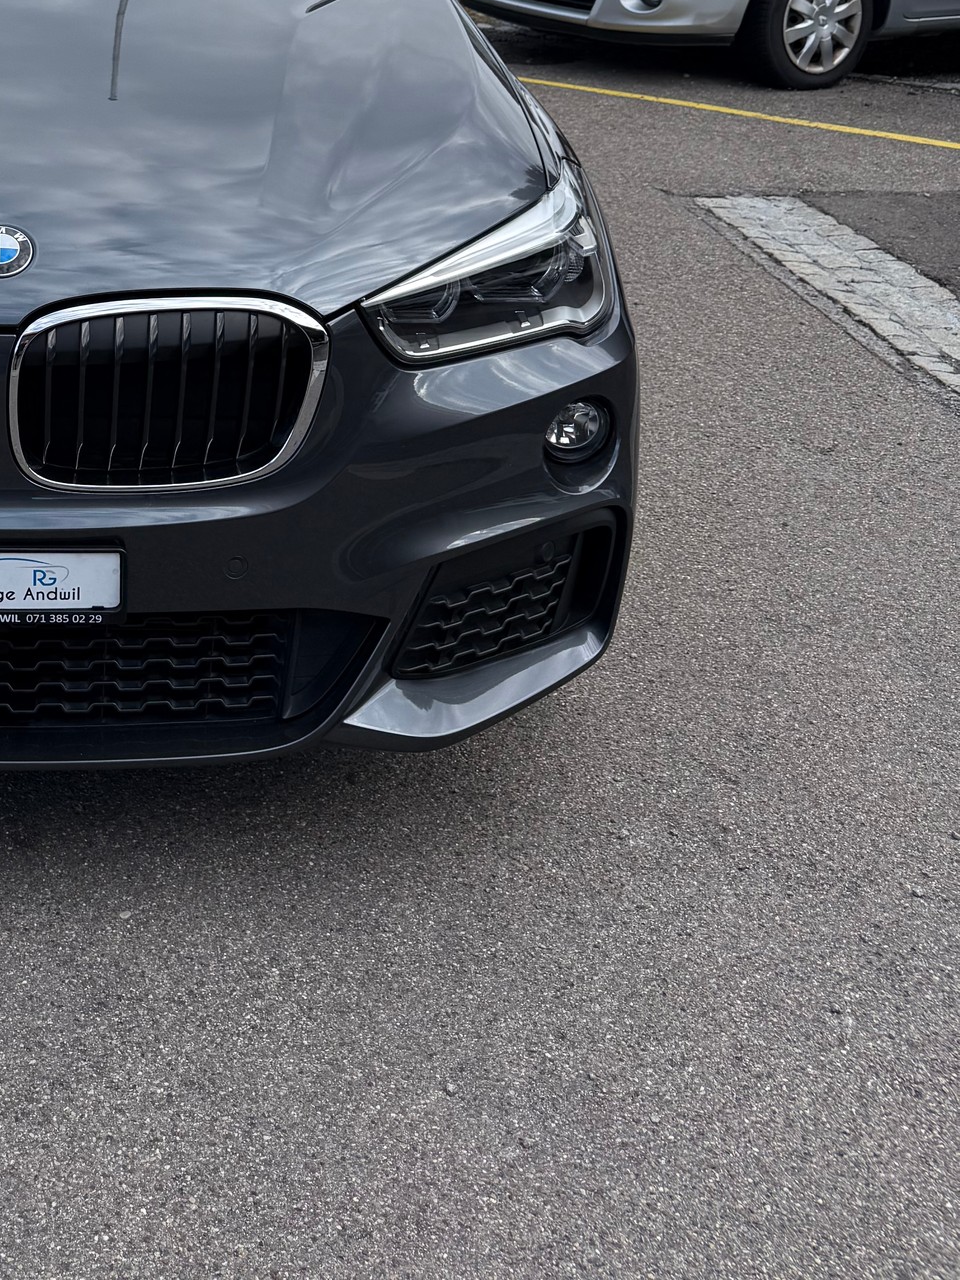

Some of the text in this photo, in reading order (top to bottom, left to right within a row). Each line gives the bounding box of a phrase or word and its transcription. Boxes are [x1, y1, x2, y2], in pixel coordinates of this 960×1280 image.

[23, 586, 81, 601] Andwil
[26, 614, 46, 623] 071
[49, 614, 69, 623] 385
[72, 614, 86, 623] 02
[89, 614, 103, 624] 29
